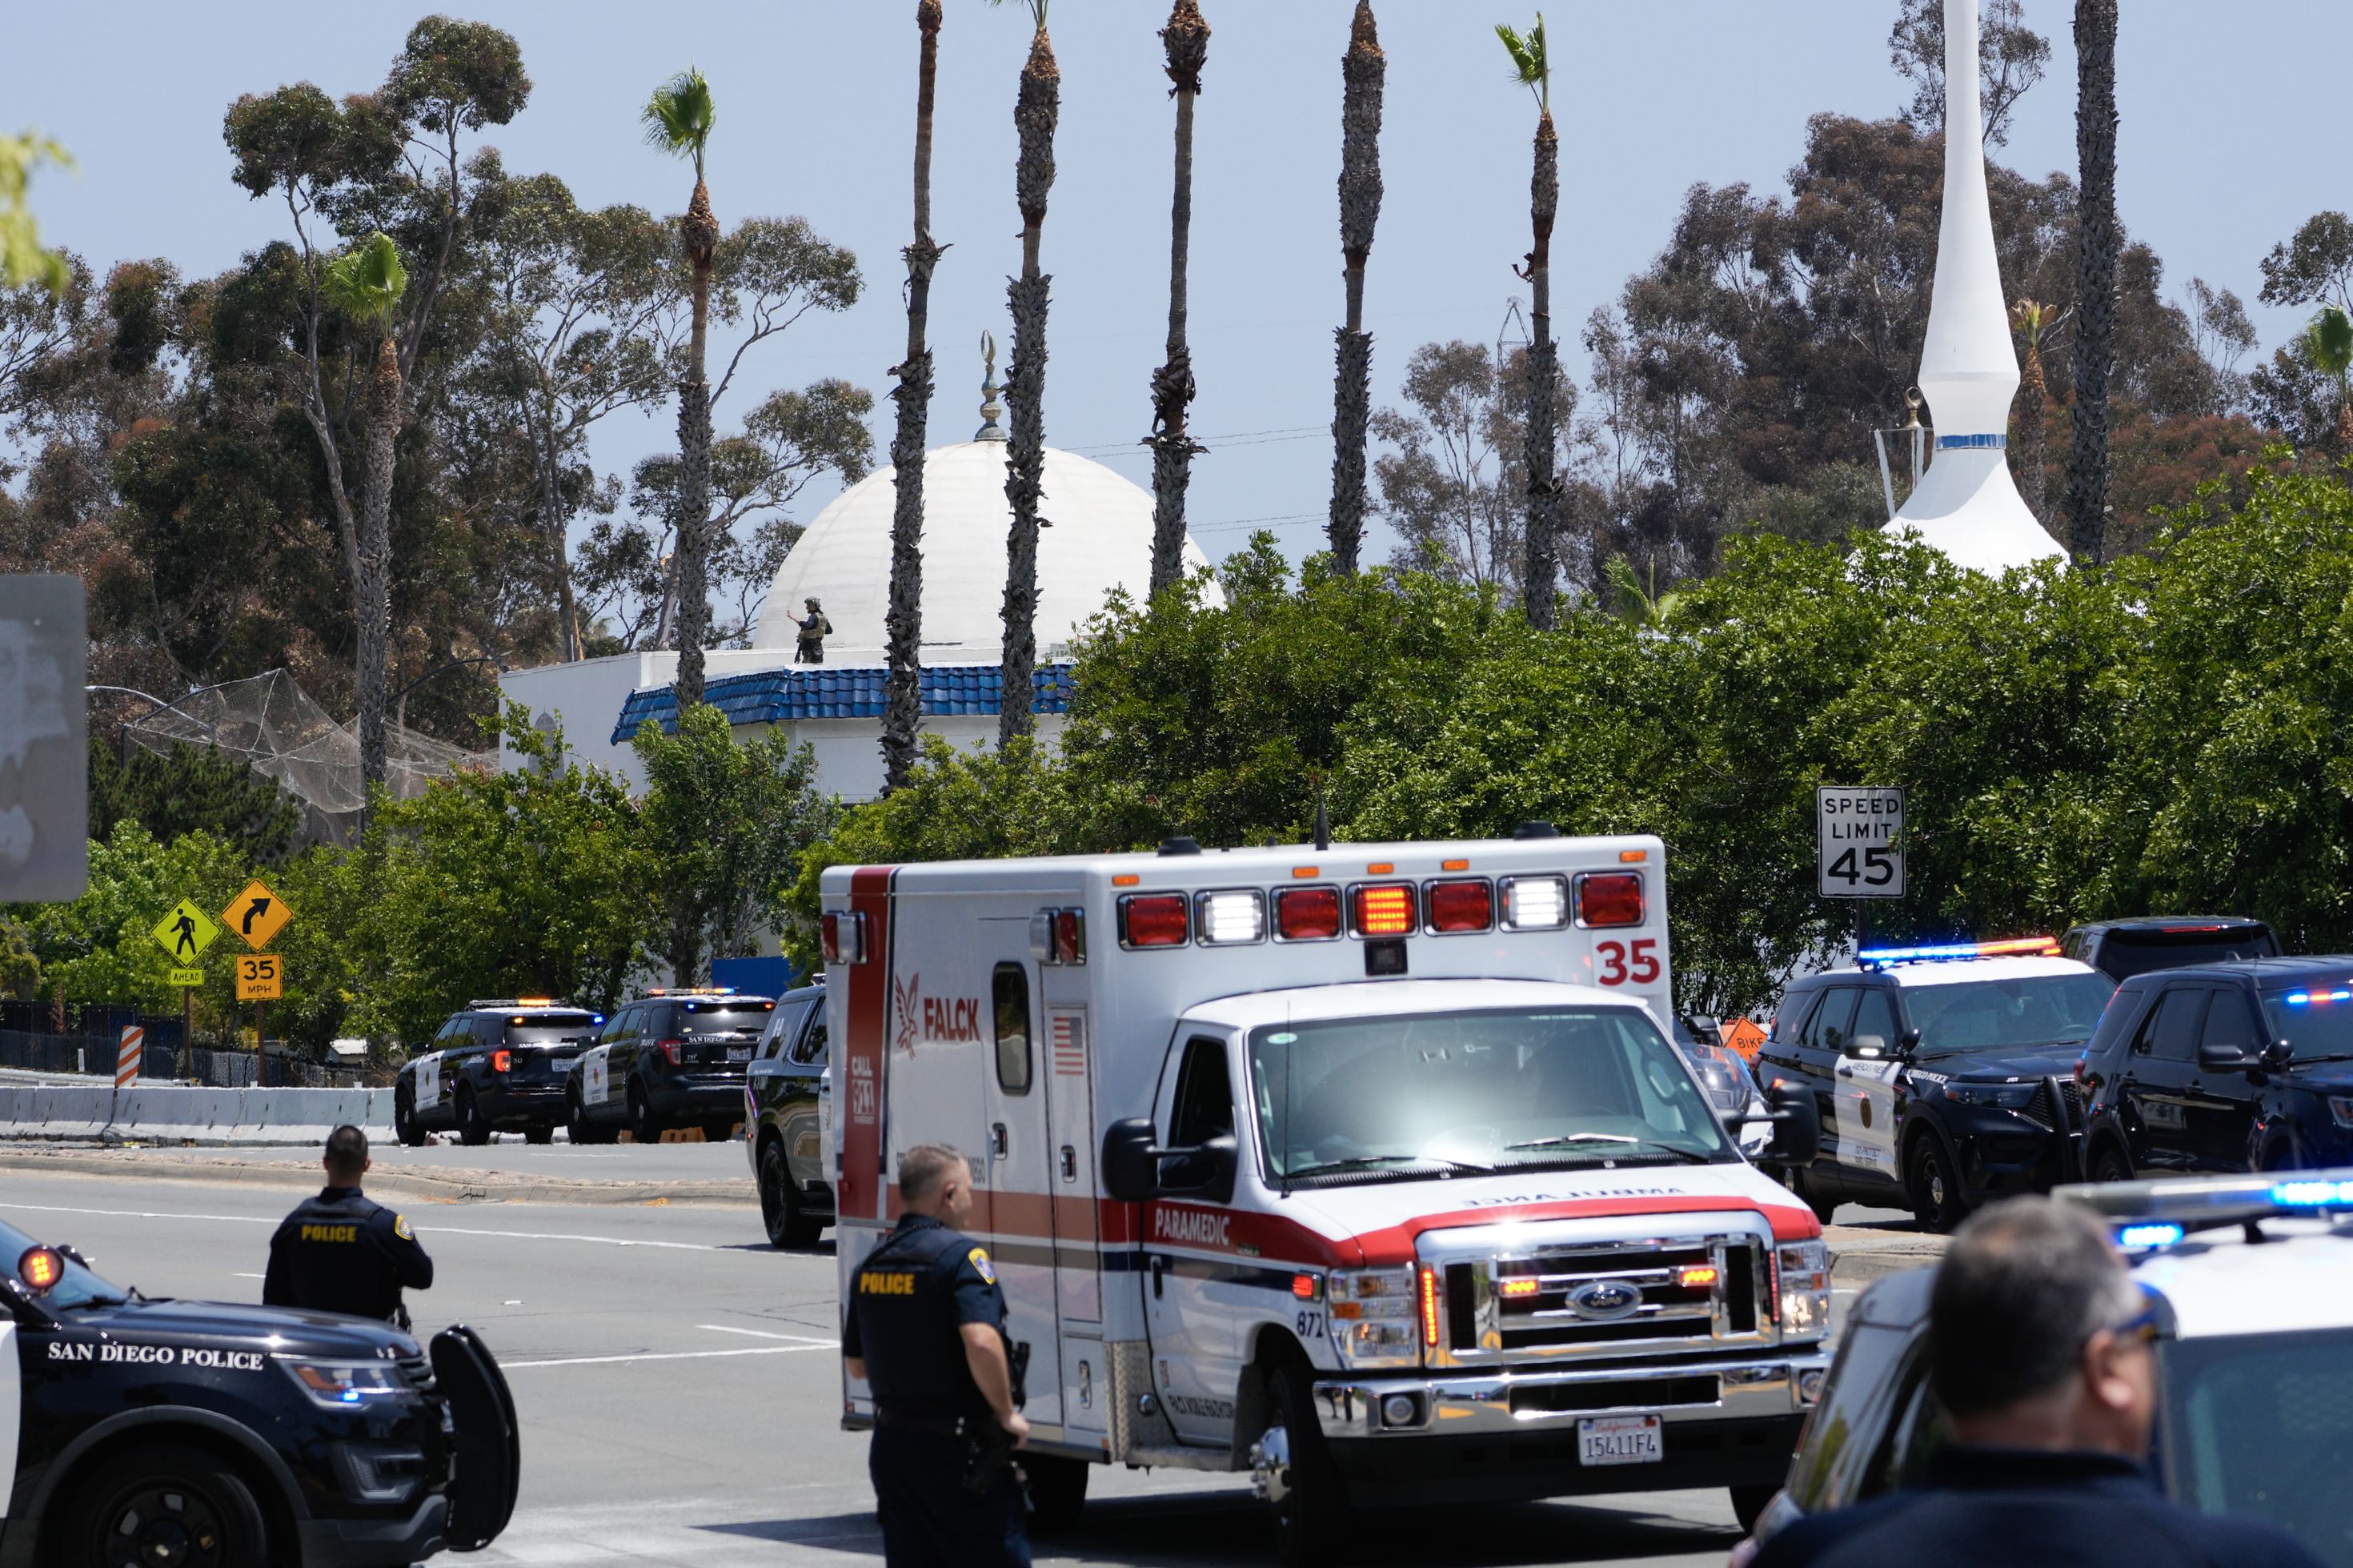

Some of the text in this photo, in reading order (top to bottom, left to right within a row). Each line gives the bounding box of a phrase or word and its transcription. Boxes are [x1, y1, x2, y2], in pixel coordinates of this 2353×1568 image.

[1825, 797, 1899, 814] SPEED
[1832, 823, 1892, 839] LIMIT
[1827, 847, 1894, 886] 45
[243, 960, 275, 981] 35
[1596, 939, 1660, 986] 35
[173, 972, 200, 981] AHEAD
[247, 985, 272, 994] MPH
[924, 997, 980, 1041] FALCK
[852, 1056, 872, 1077] CALL
[1927, 1073, 1949, 1085] POLICE
[301, 1225, 358, 1241] POLICE
[1155, 1208, 1230, 1245] PARAMEDIC
[860, 1273, 915, 1294] POLICE
[1297, 1311, 1324, 1338] 872
[48, 1342, 263, 1370] SAN DIEGO POLICE
[1595, 1421, 1643, 1434] California
[1586, 1434, 1657, 1458] 15411F4
